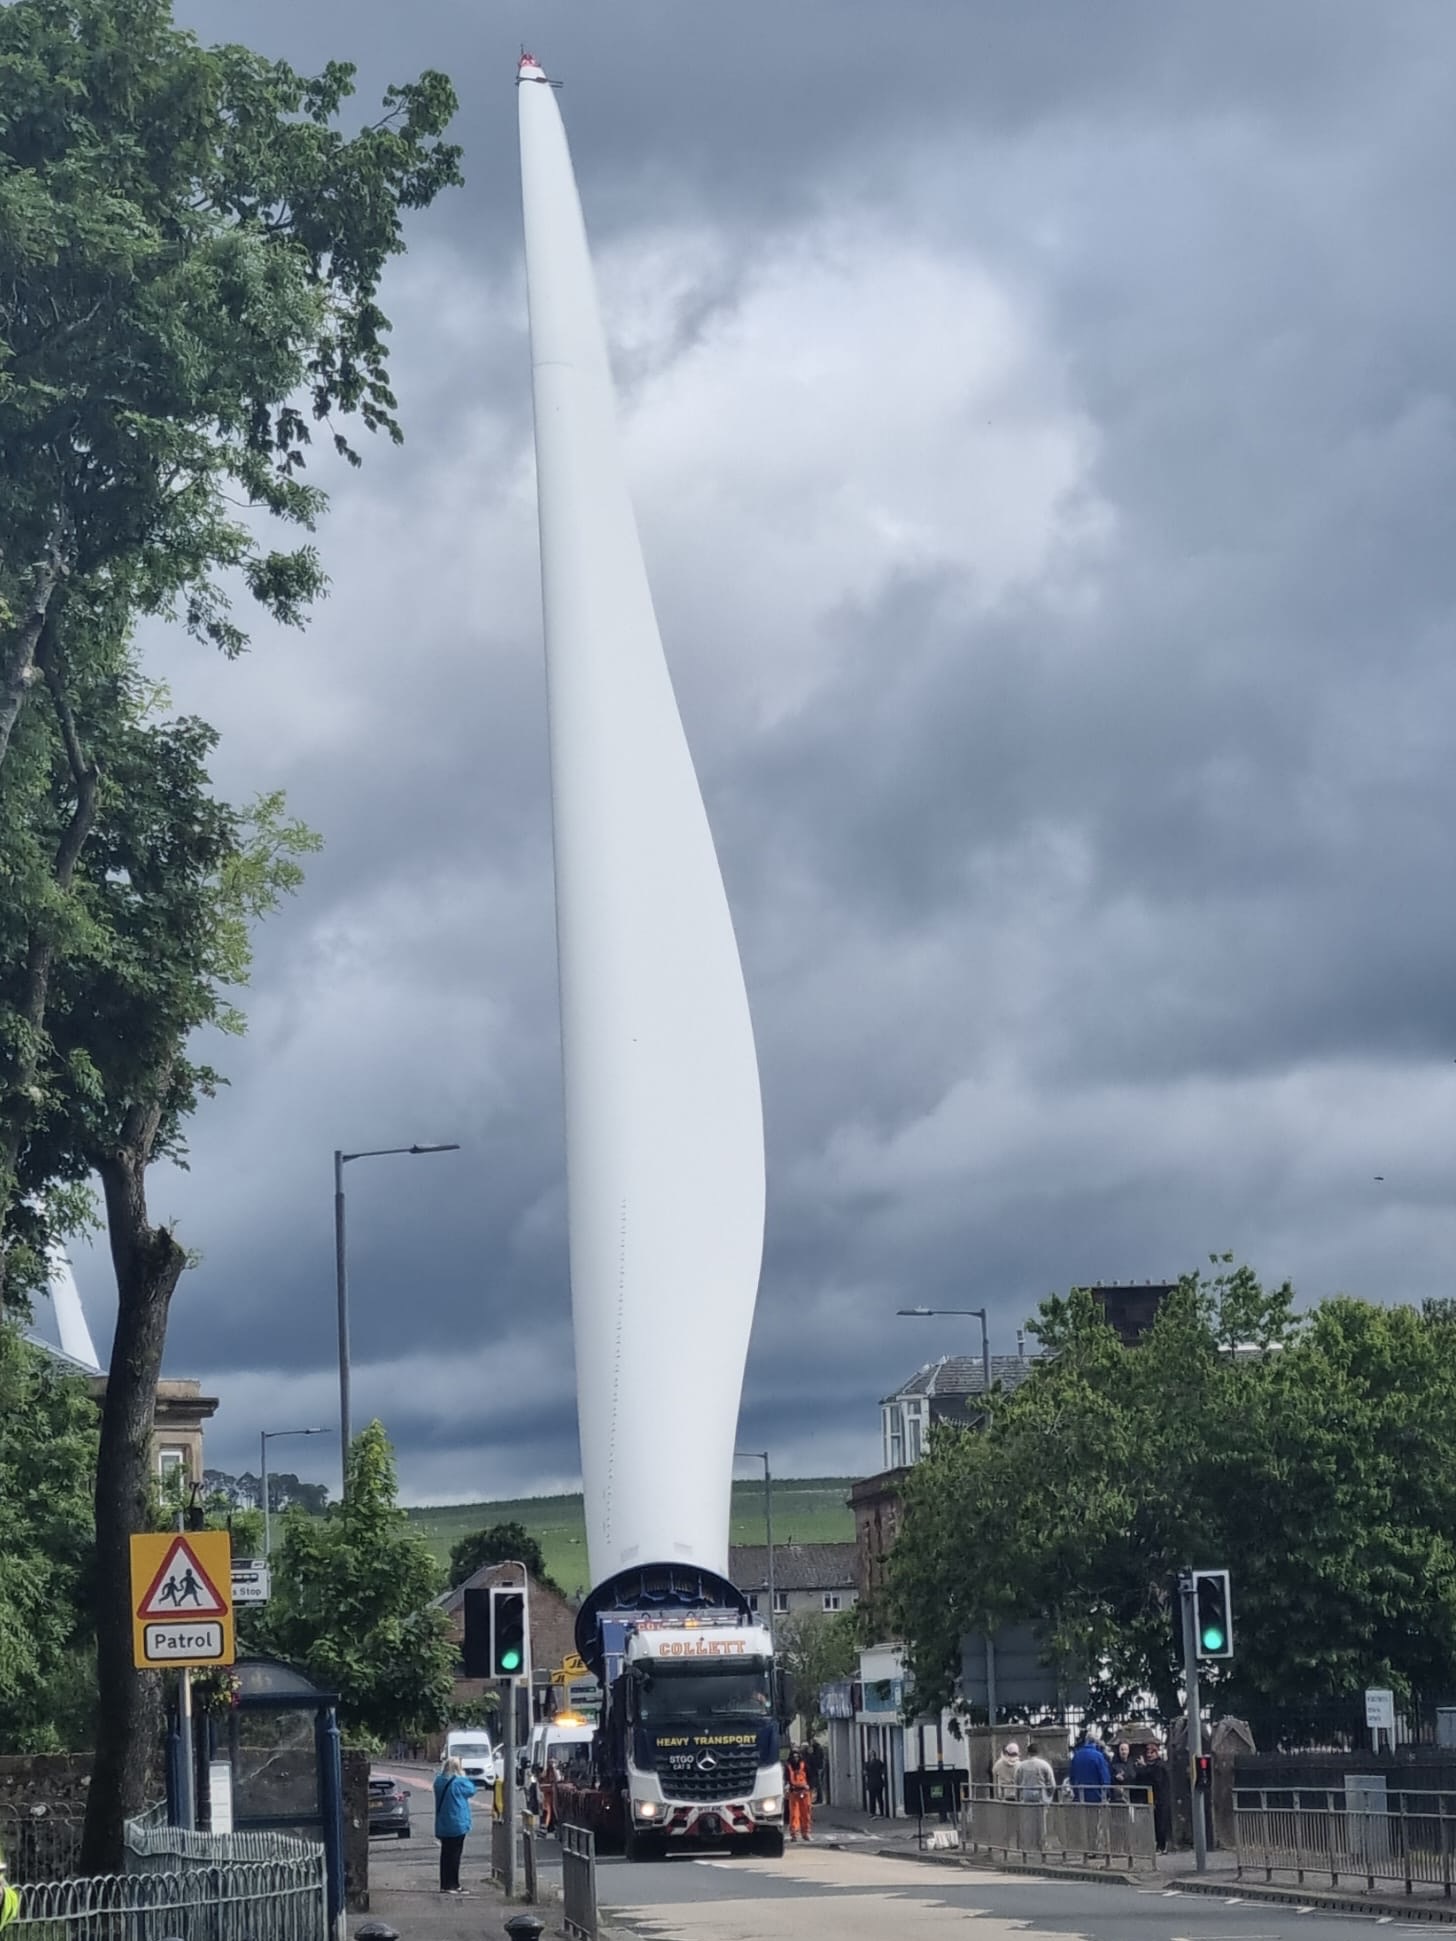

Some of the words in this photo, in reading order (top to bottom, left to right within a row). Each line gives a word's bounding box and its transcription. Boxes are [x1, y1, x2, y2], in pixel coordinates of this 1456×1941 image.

[240, 1587, 262, 1597] Stop
[154, 1632, 213, 1649] Patrol
[659, 1640, 746, 1656] COLLETT
[569, 1659, 584, 1669] JE
[656, 1738, 689, 1747] HEAVY
[694, 1735, 757, 1744] TRANSPORT
[669, 1755, 694, 1763] STGO
